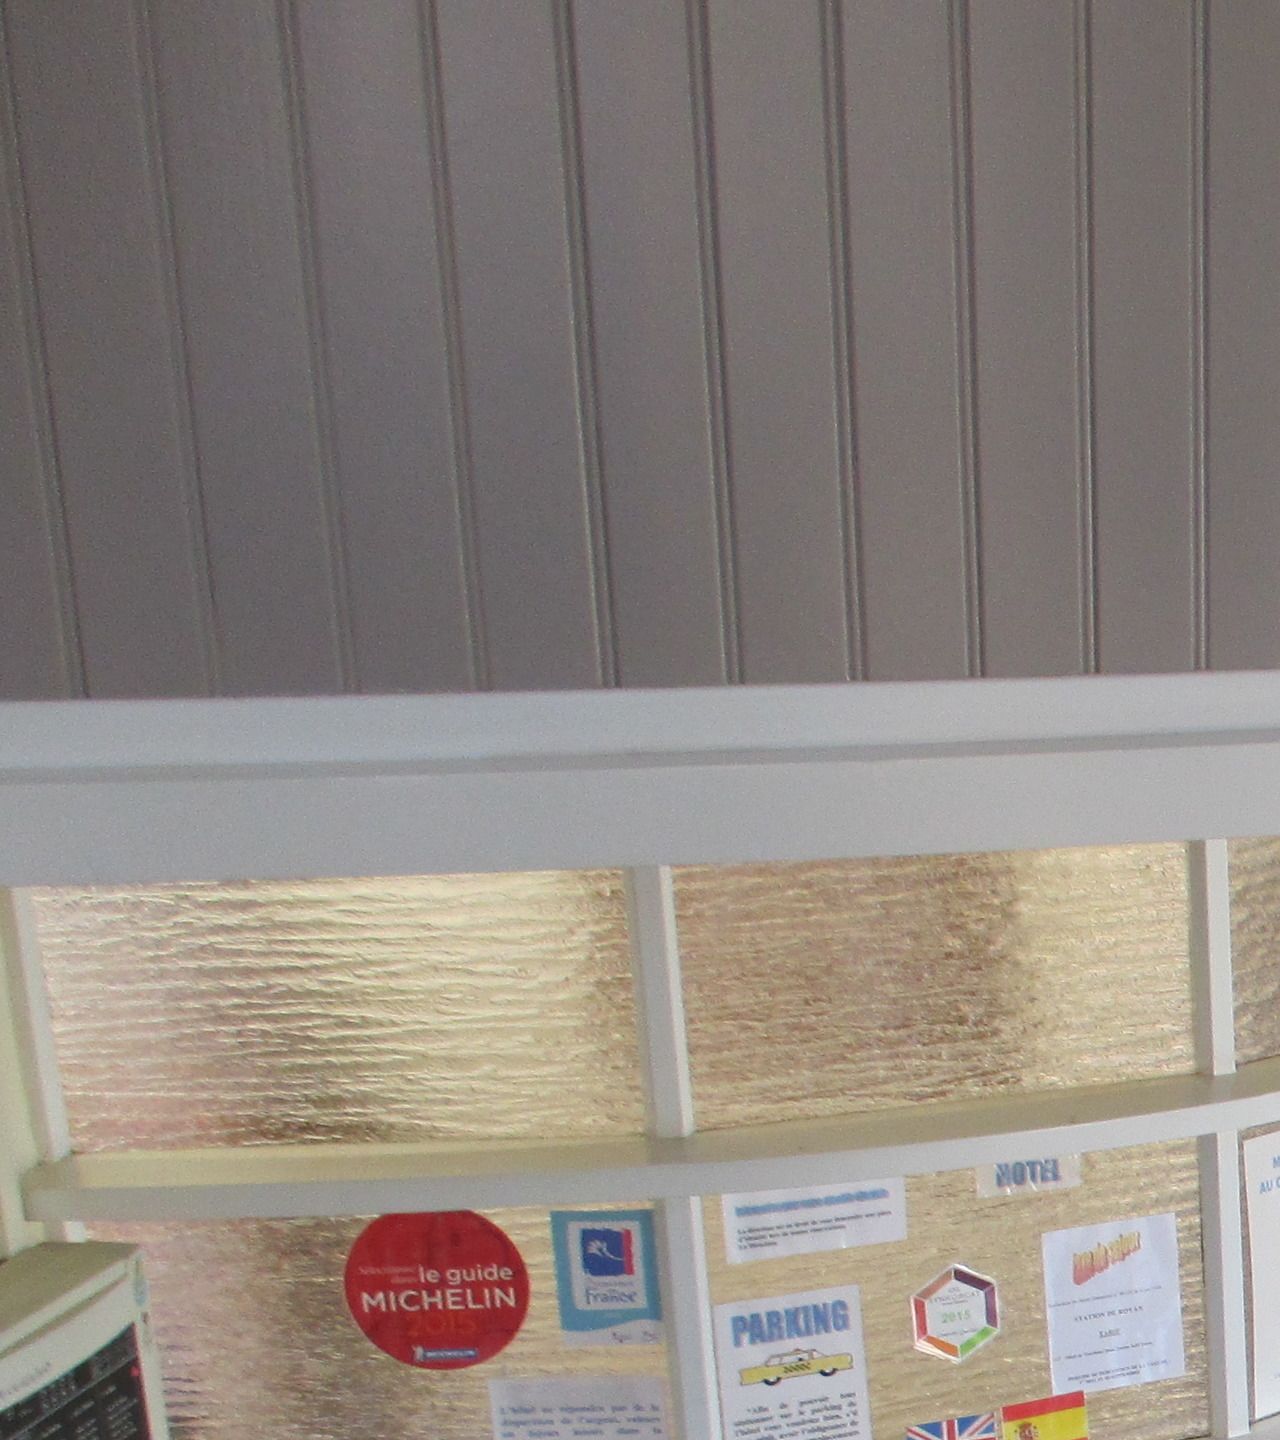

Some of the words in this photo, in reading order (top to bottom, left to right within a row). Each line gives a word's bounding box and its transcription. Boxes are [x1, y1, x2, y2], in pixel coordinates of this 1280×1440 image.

[1259, 1180, 1274, 1195] AU
[419, 1264, 440, 1284] le
[446, 1264, 514, 1286] guide
[361, 1288, 517, 1314] MICHELIN
[407, 1313, 477, 1335] 2015
[731, 1299, 850, 1348] PARKING
[941, 1310, 972, 1325] 2015
